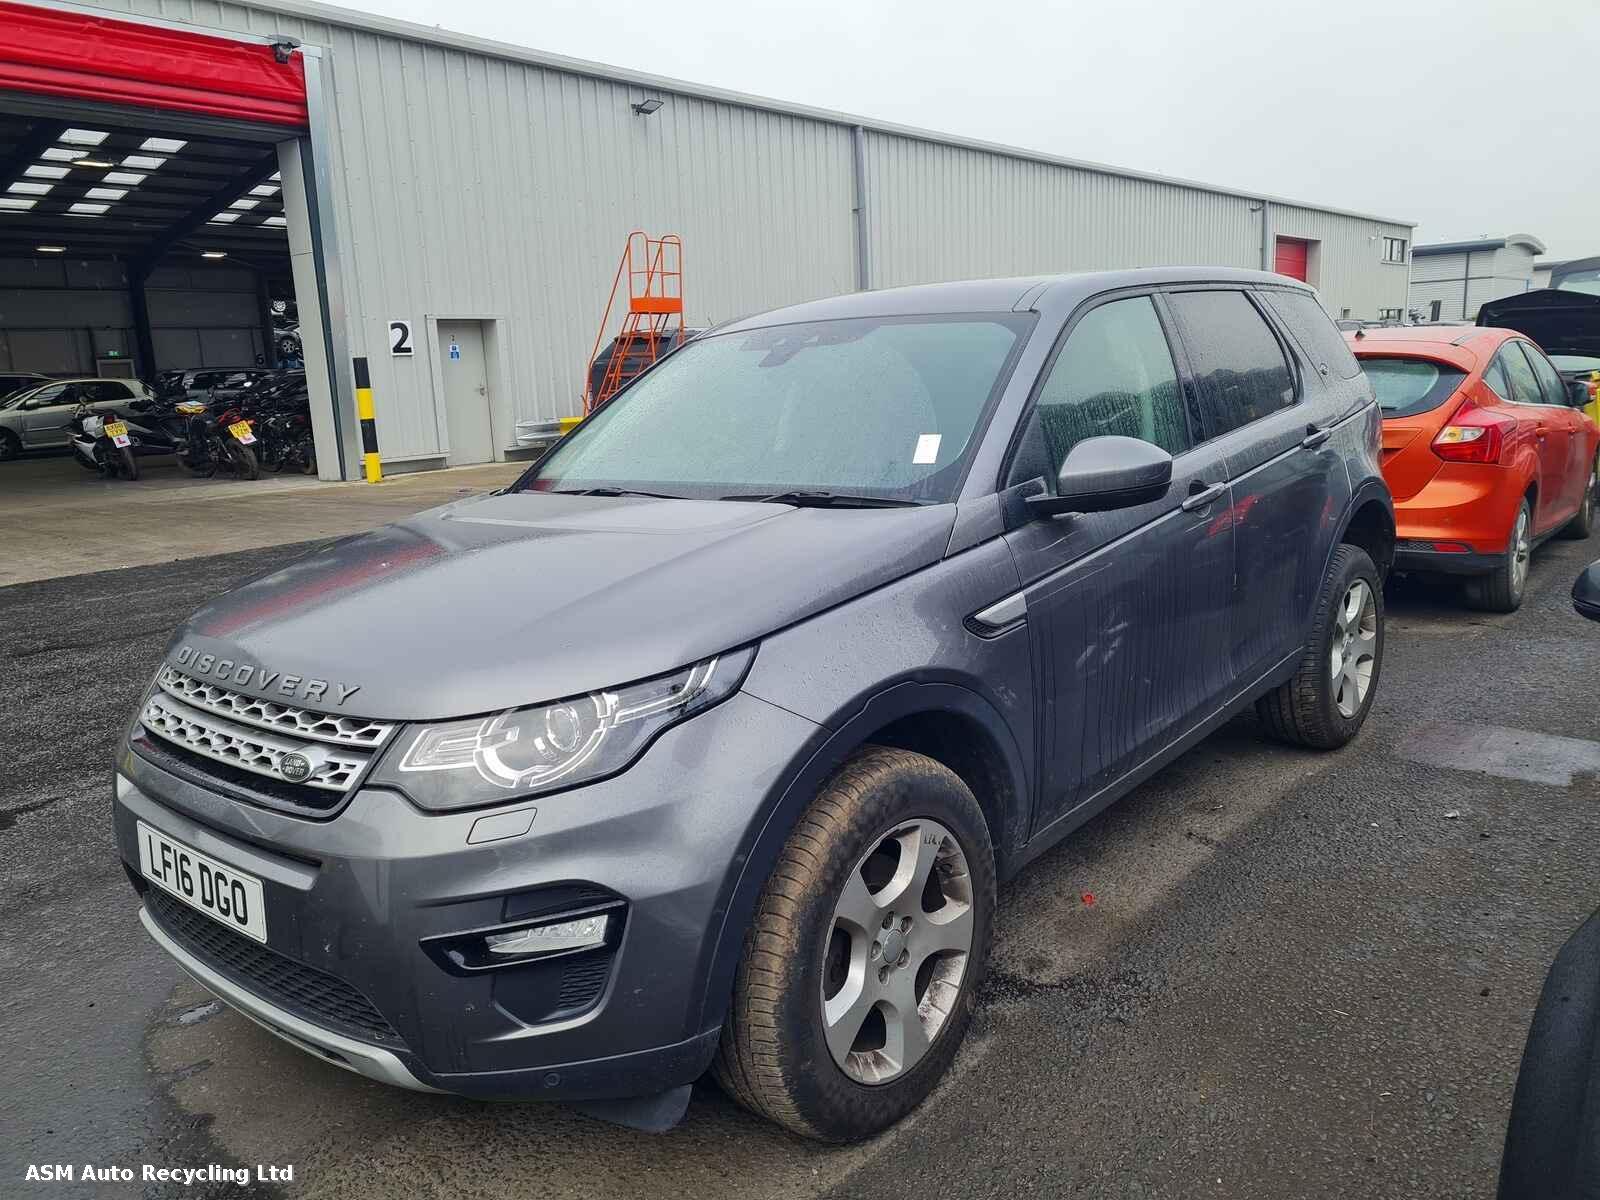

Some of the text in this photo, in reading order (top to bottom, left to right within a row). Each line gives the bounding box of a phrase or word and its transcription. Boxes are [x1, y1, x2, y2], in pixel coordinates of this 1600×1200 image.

[390, 322, 412, 353] 2
[177, 646, 361, 705] DISCOVERY
[148, 834, 248, 926] LF16 DGO
